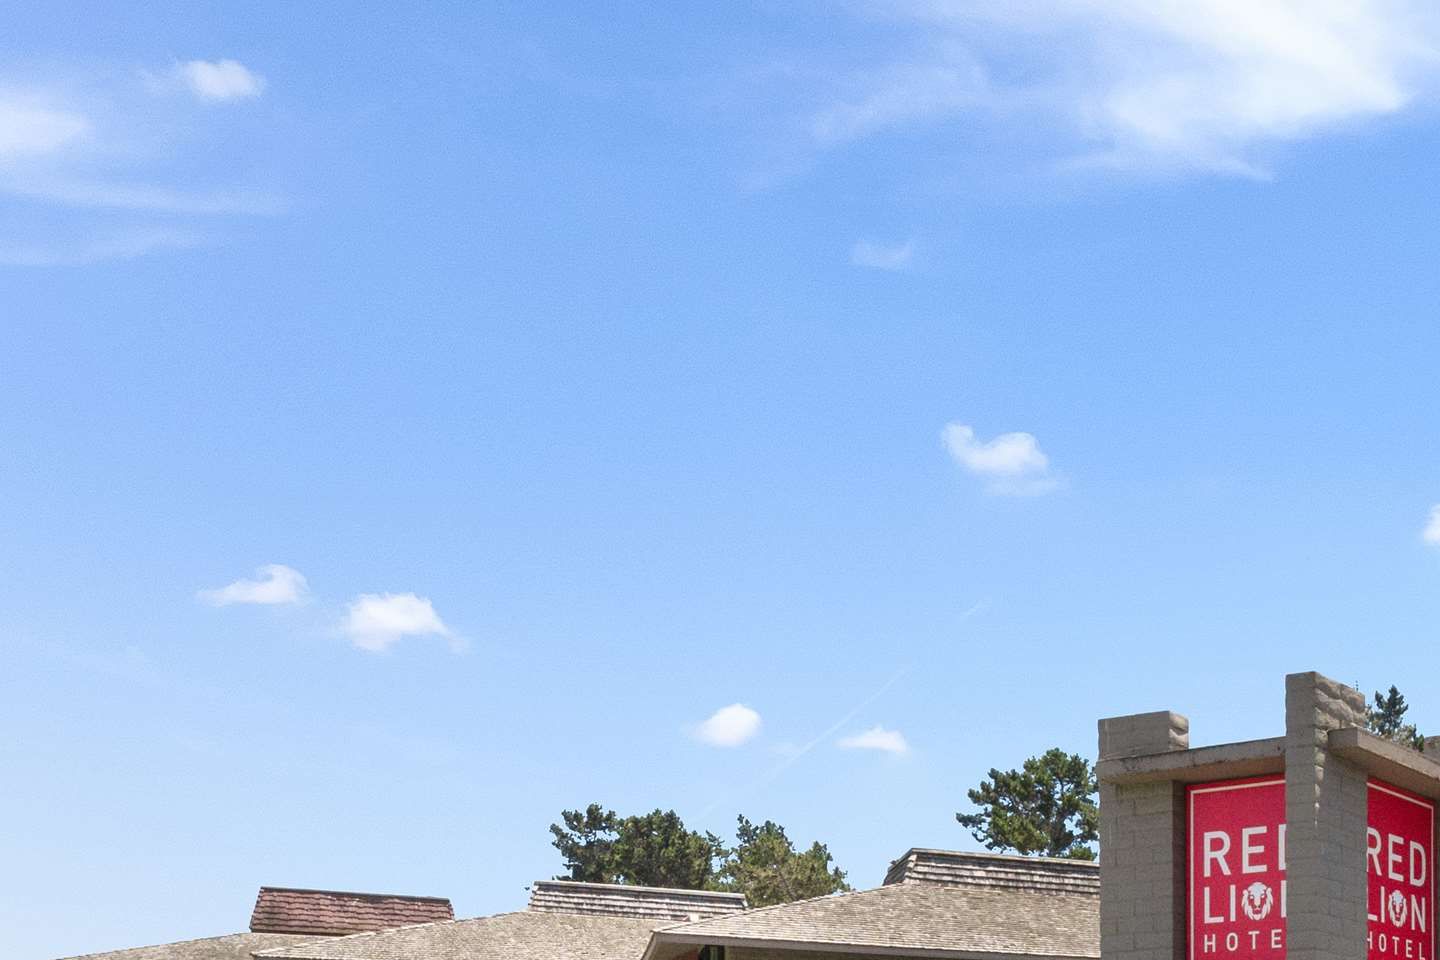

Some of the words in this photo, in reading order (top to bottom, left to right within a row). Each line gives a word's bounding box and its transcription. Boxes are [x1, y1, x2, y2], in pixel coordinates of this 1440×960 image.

[1203, 823, 1286, 878] RE
[1366, 826, 1426, 887] RED
[1203, 880, 1286, 924] LIO
[1204, 929, 1282, 953] HOTE
